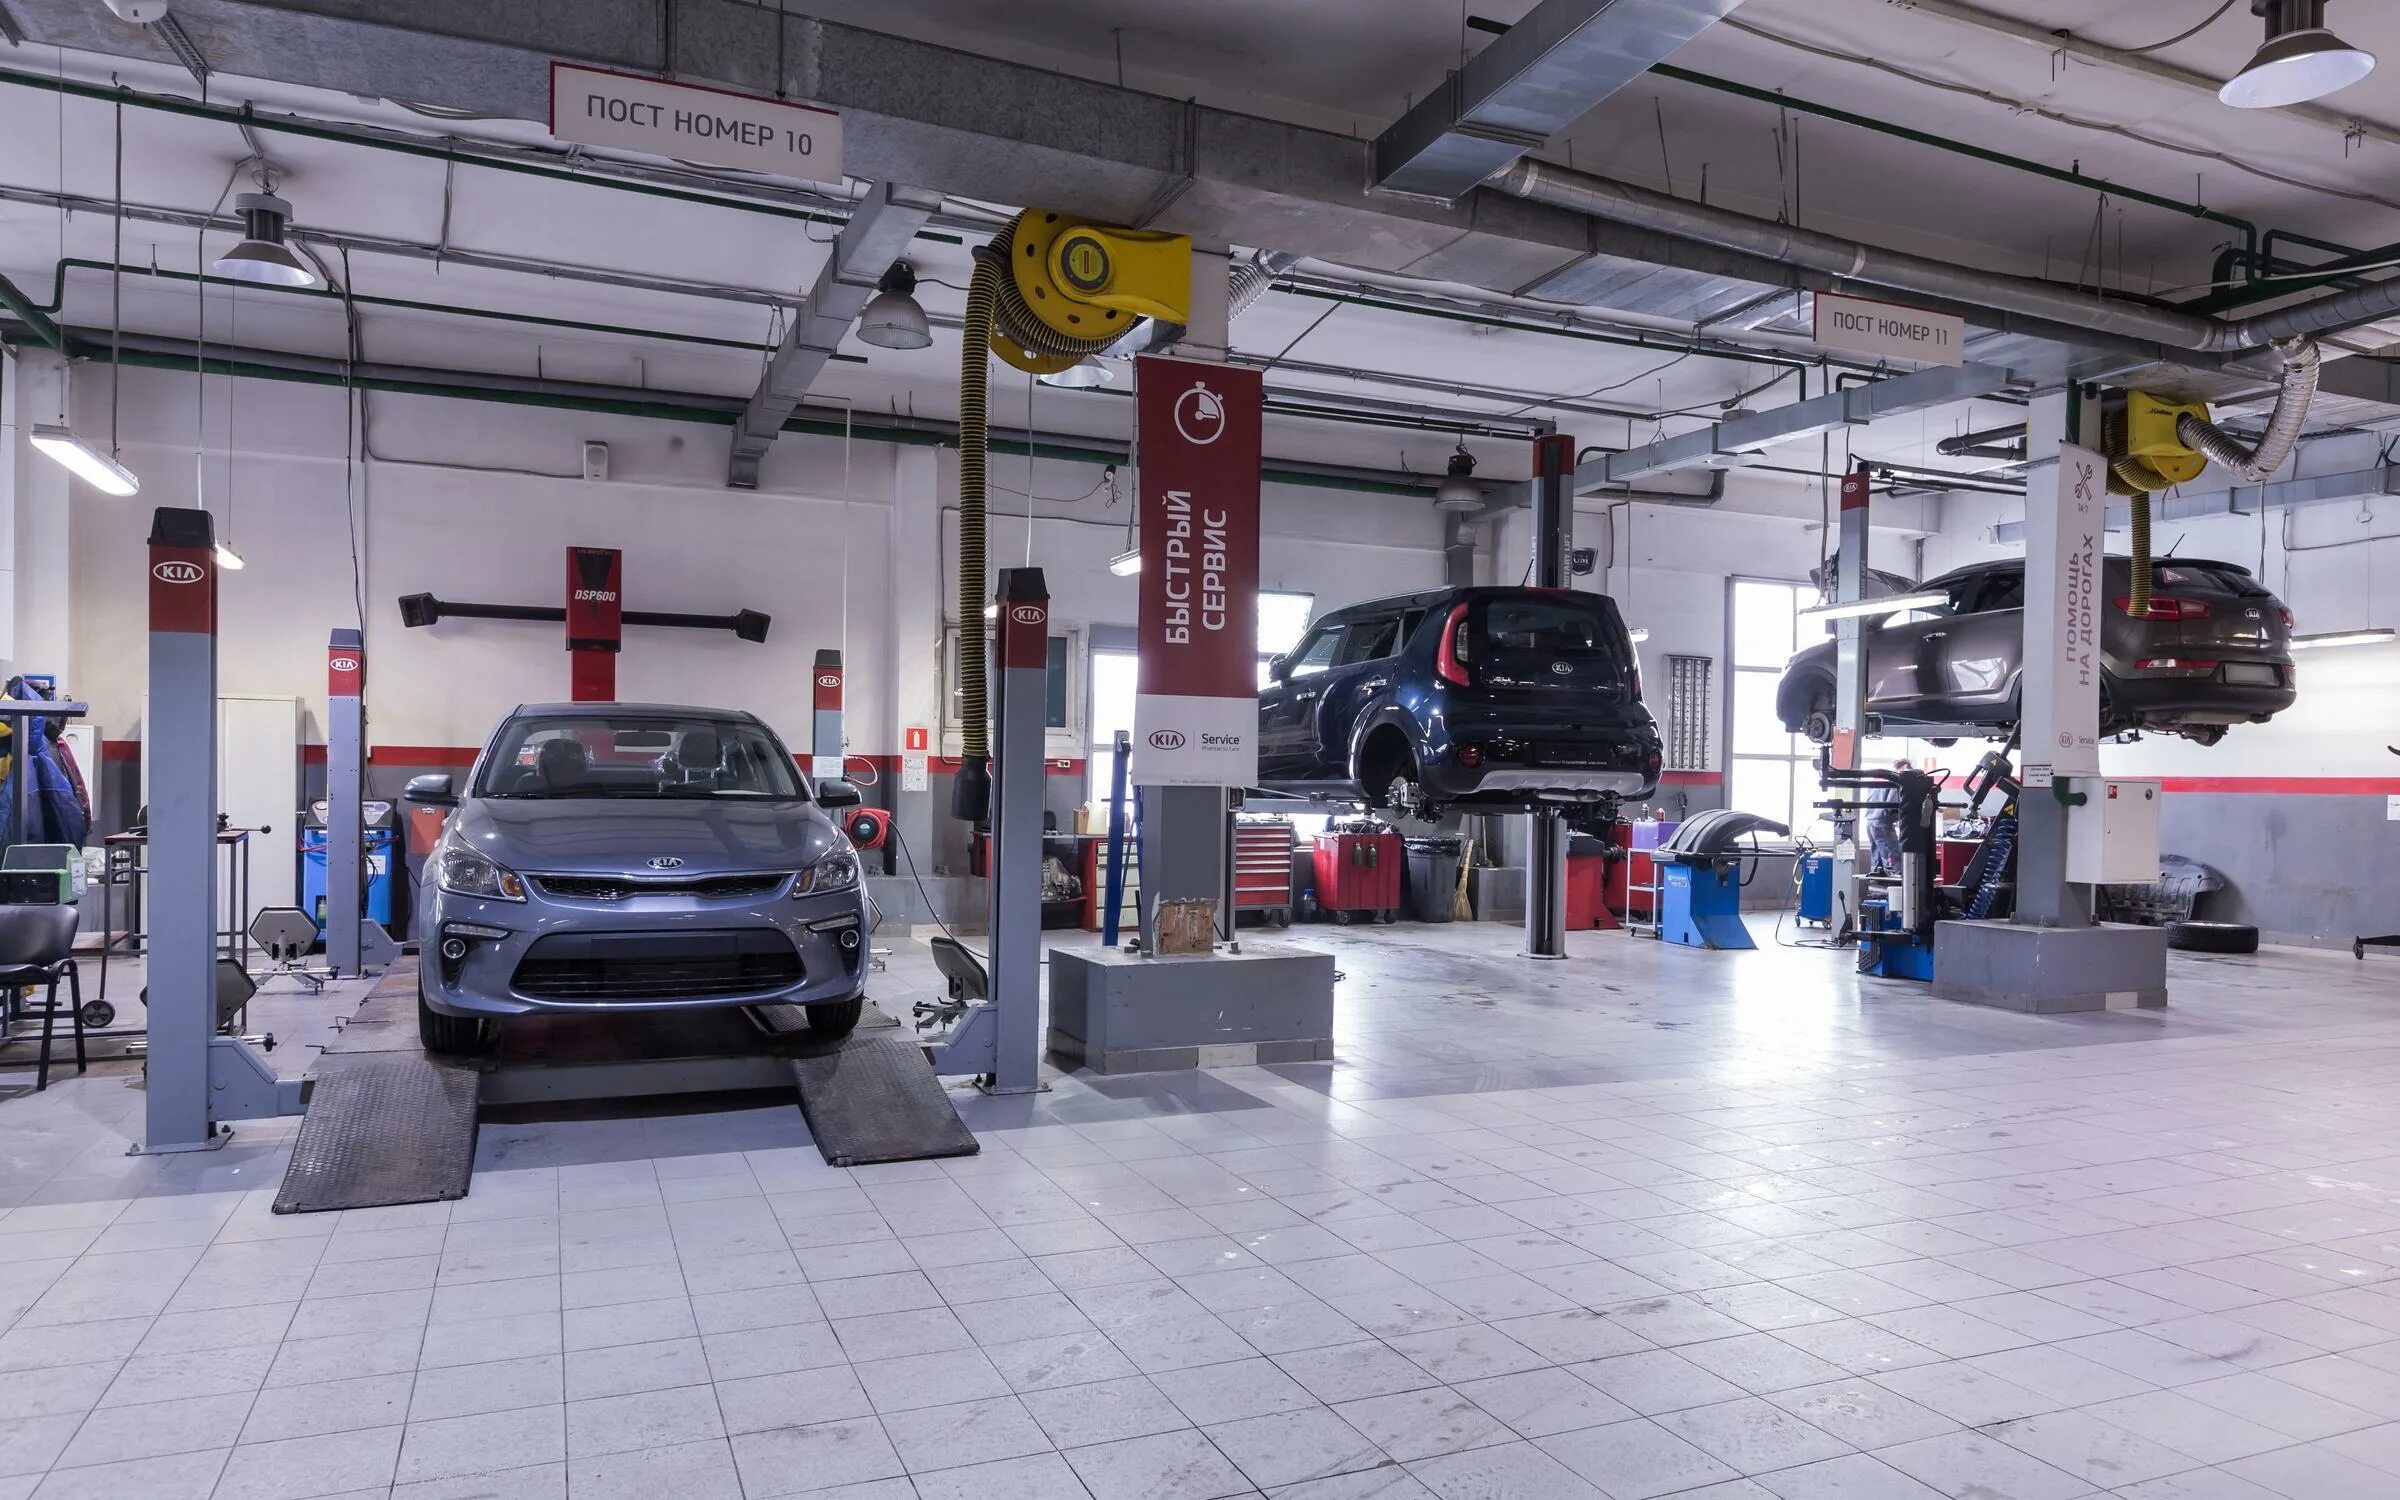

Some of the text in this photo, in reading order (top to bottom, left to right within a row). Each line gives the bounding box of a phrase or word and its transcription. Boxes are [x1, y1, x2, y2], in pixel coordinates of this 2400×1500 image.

[587, 94, 812, 155] ПОСТ НОМЕР 10
[1834, 312, 1948, 345] ПОСТ НОМЕР 11
[574, 589, 616, 602] DSP600
[1162, 490, 1192, 644] БЫСТРЫЙ
[1202, 508, 1227, 631] СЕРВИС
[2066, 552, 2079, 662] ПОМОЩЬ
[2079, 533, 2094, 686] НА ДОРОГАХ
[1201, 733, 1240, 745] Service
